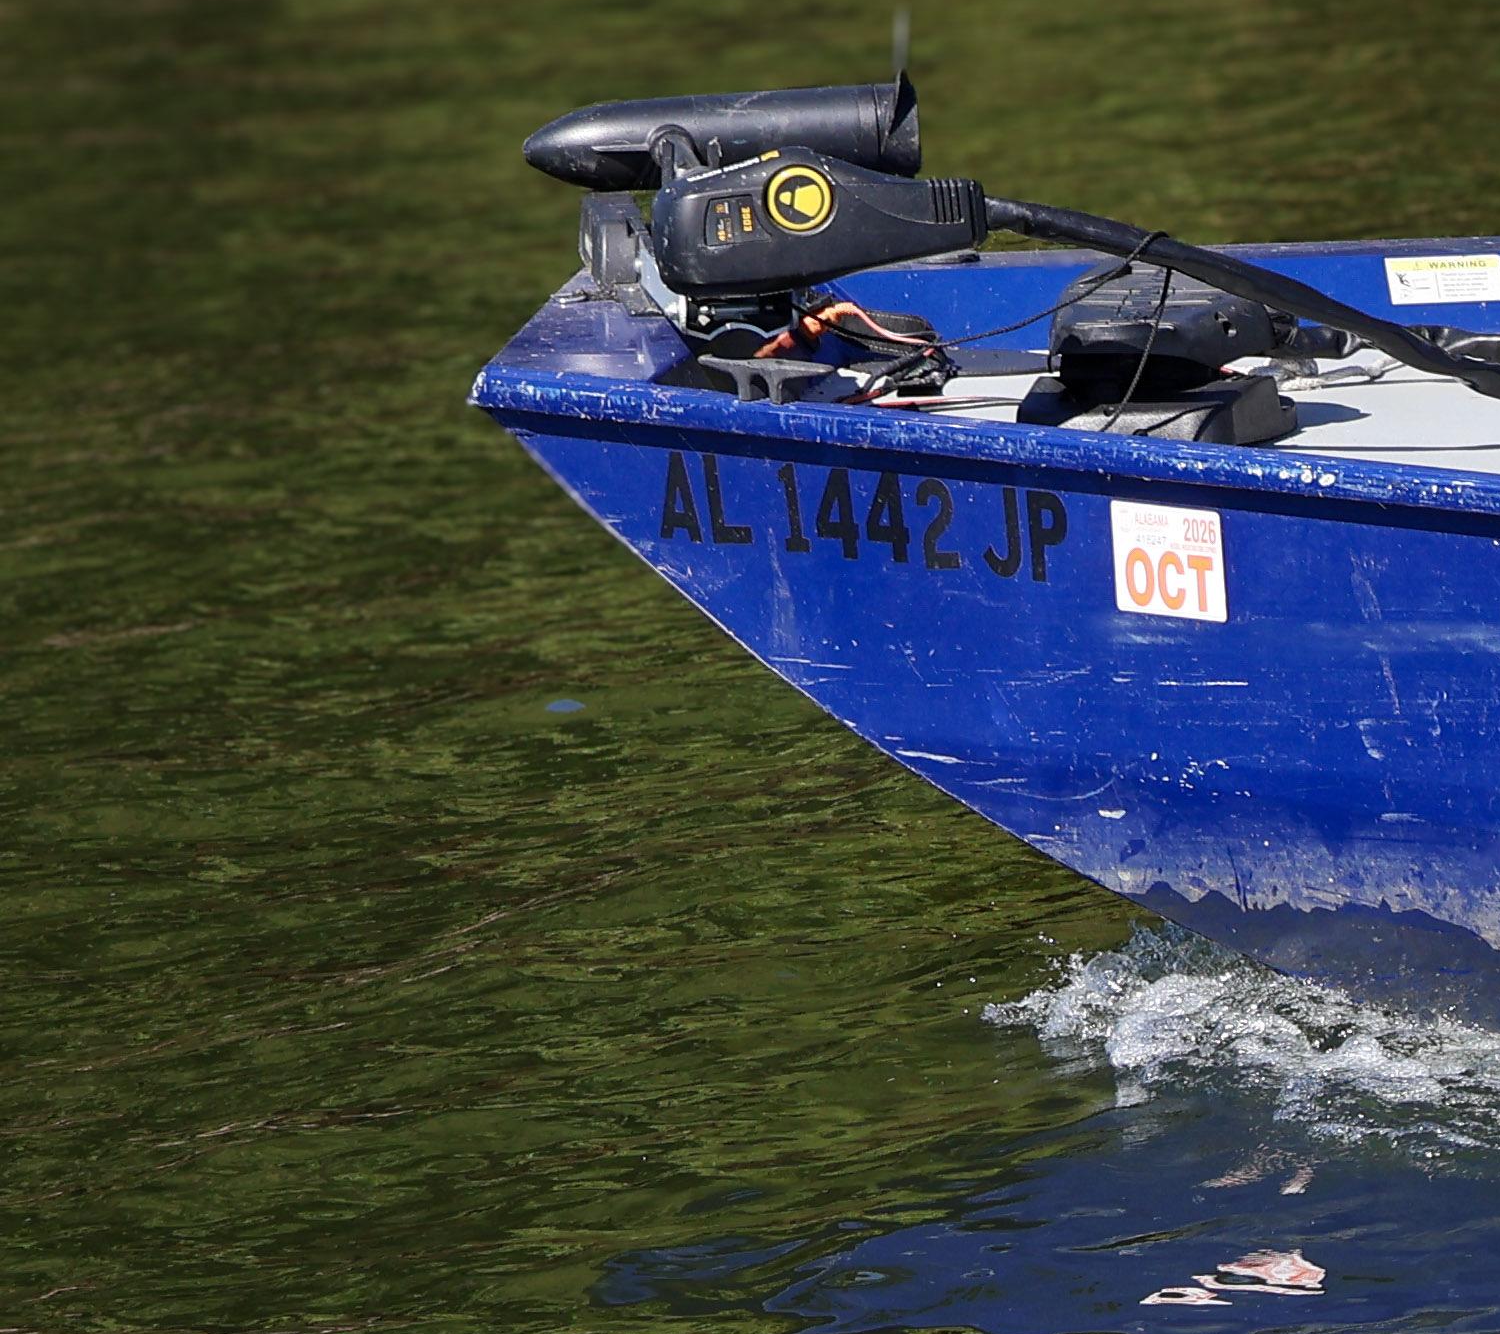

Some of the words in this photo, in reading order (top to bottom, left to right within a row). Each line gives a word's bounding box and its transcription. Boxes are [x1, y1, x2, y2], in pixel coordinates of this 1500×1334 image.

[741, 206, 753, 232] EDGE
[1428, 260, 1488, 269] WARNING
[660, 451, 753, 545] AL
[778, 463, 961, 569] 1442
[983, 486, 1068, 582] JP
[1183, 518, 1217, 544] 2026
[1125, 547, 1213, 612] OCT
